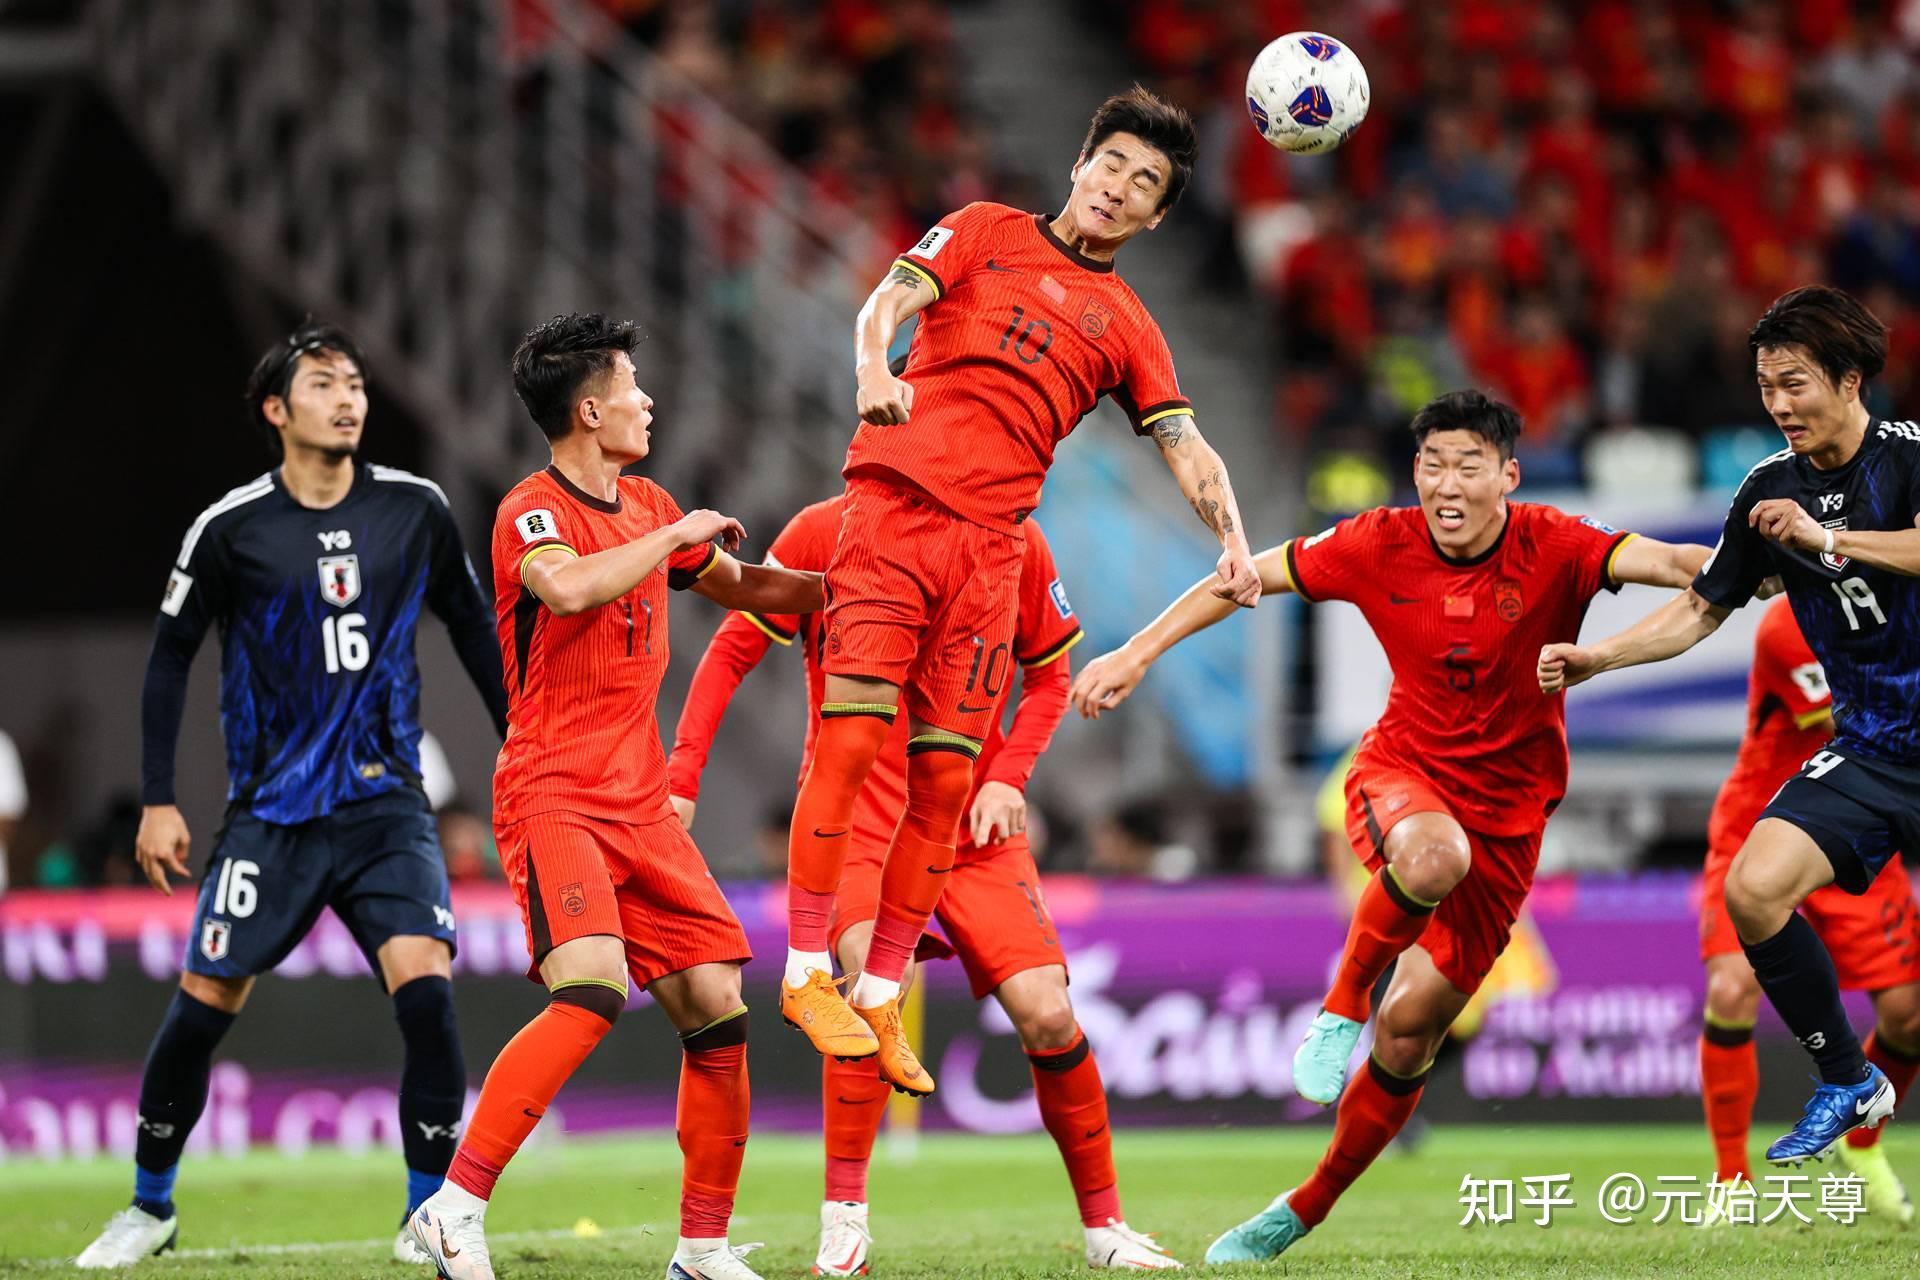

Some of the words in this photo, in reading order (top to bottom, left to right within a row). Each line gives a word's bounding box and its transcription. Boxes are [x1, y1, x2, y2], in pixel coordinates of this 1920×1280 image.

[999, 305, 1054, 364] 10
[1818, 493, 1845, 513] Y-3
[317, 529, 352, 552] Y-3
[1831, 576, 1888, 631] 19
[322, 613, 370, 674] 16
[965, 635, 1009, 697] 10
[1445, 647, 1476, 692] 5
[214, 857, 260, 919] 16
